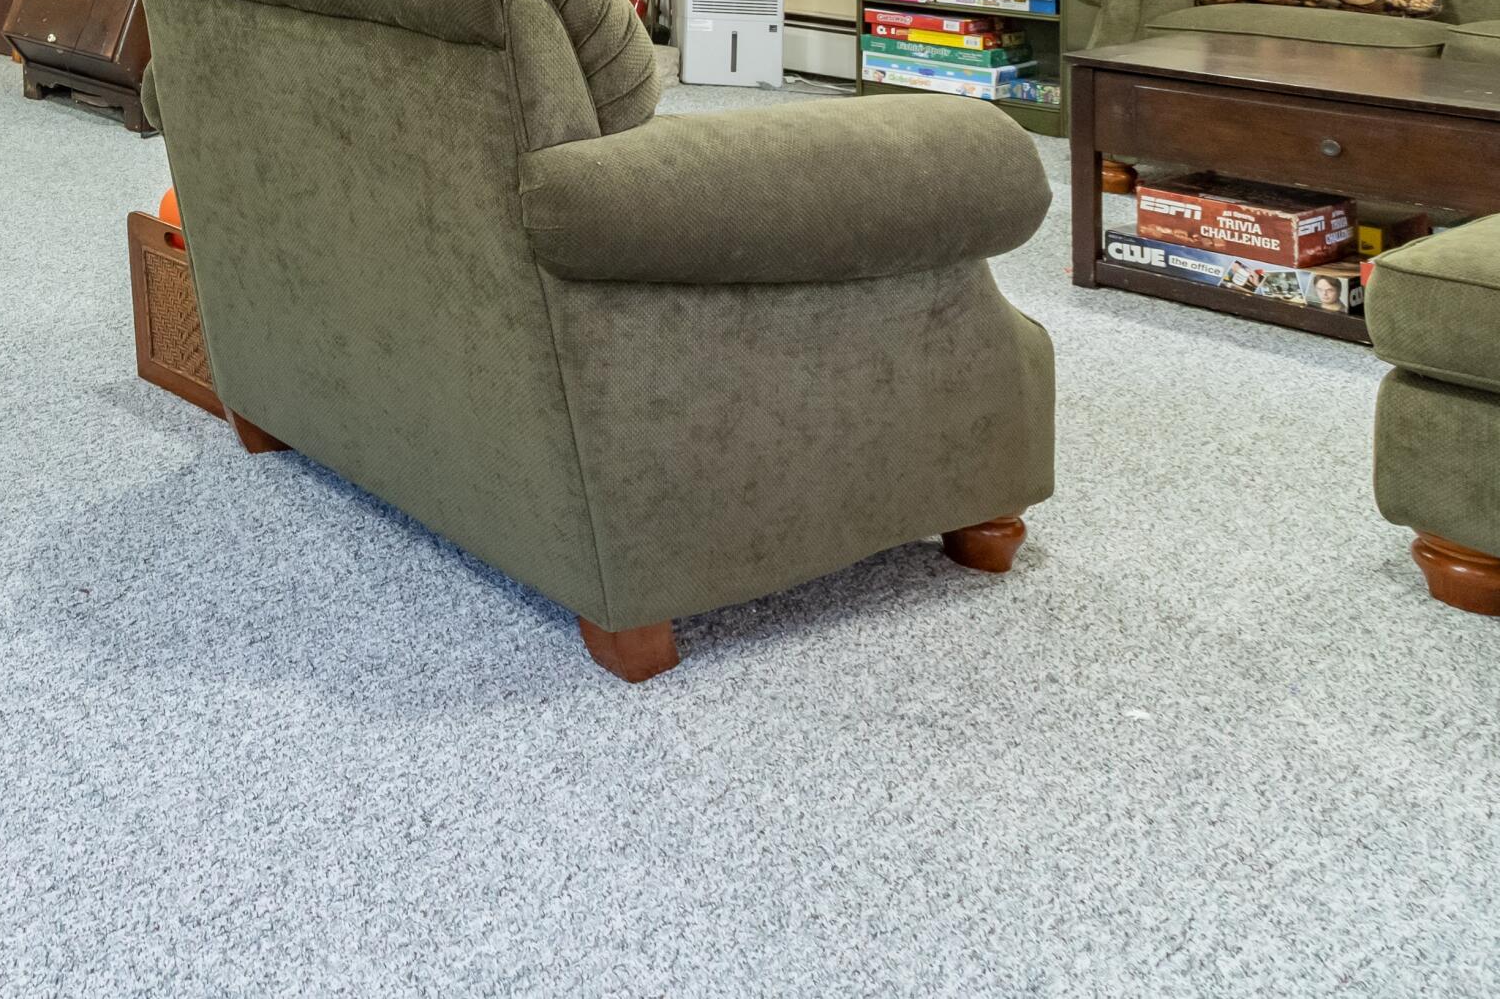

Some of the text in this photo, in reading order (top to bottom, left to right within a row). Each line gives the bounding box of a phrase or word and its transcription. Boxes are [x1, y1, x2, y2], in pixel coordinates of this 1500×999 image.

[1139, 195, 1202, 221] ESPN
[1200, 225, 1281, 251] CHALLENGE
[1216, 216, 1262, 236] TRIVIA
[1298, 215, 1326, 237] ESPN
[1107, 241, 1221, 277] CLUE the office
